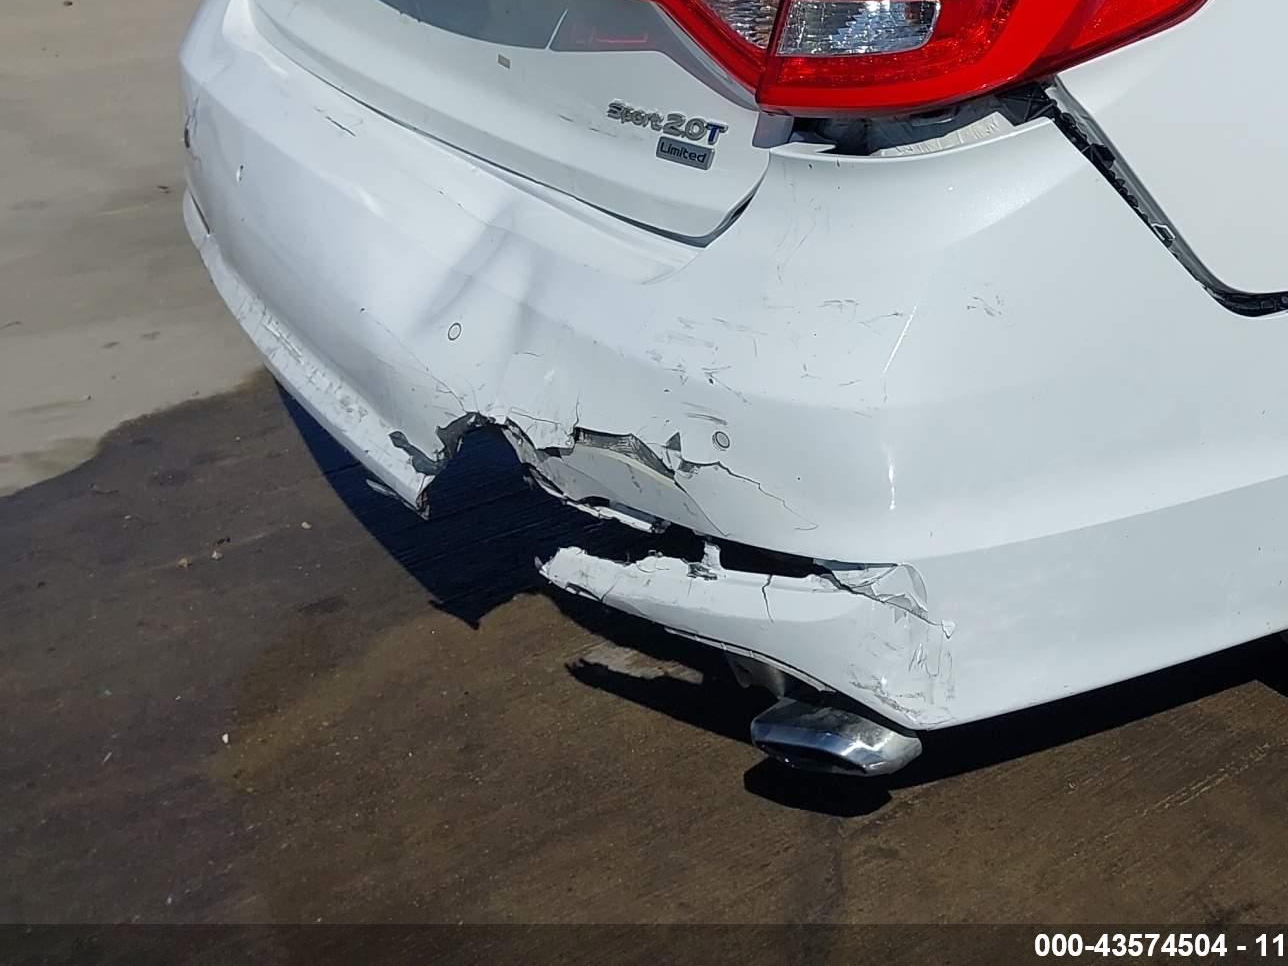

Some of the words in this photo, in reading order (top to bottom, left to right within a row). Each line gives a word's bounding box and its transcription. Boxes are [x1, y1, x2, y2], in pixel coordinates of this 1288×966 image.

[607, 101, 664, 132] Sport
[662, 113, 729, 146] 2.0T
[660, 141, 707, 164] Limited
